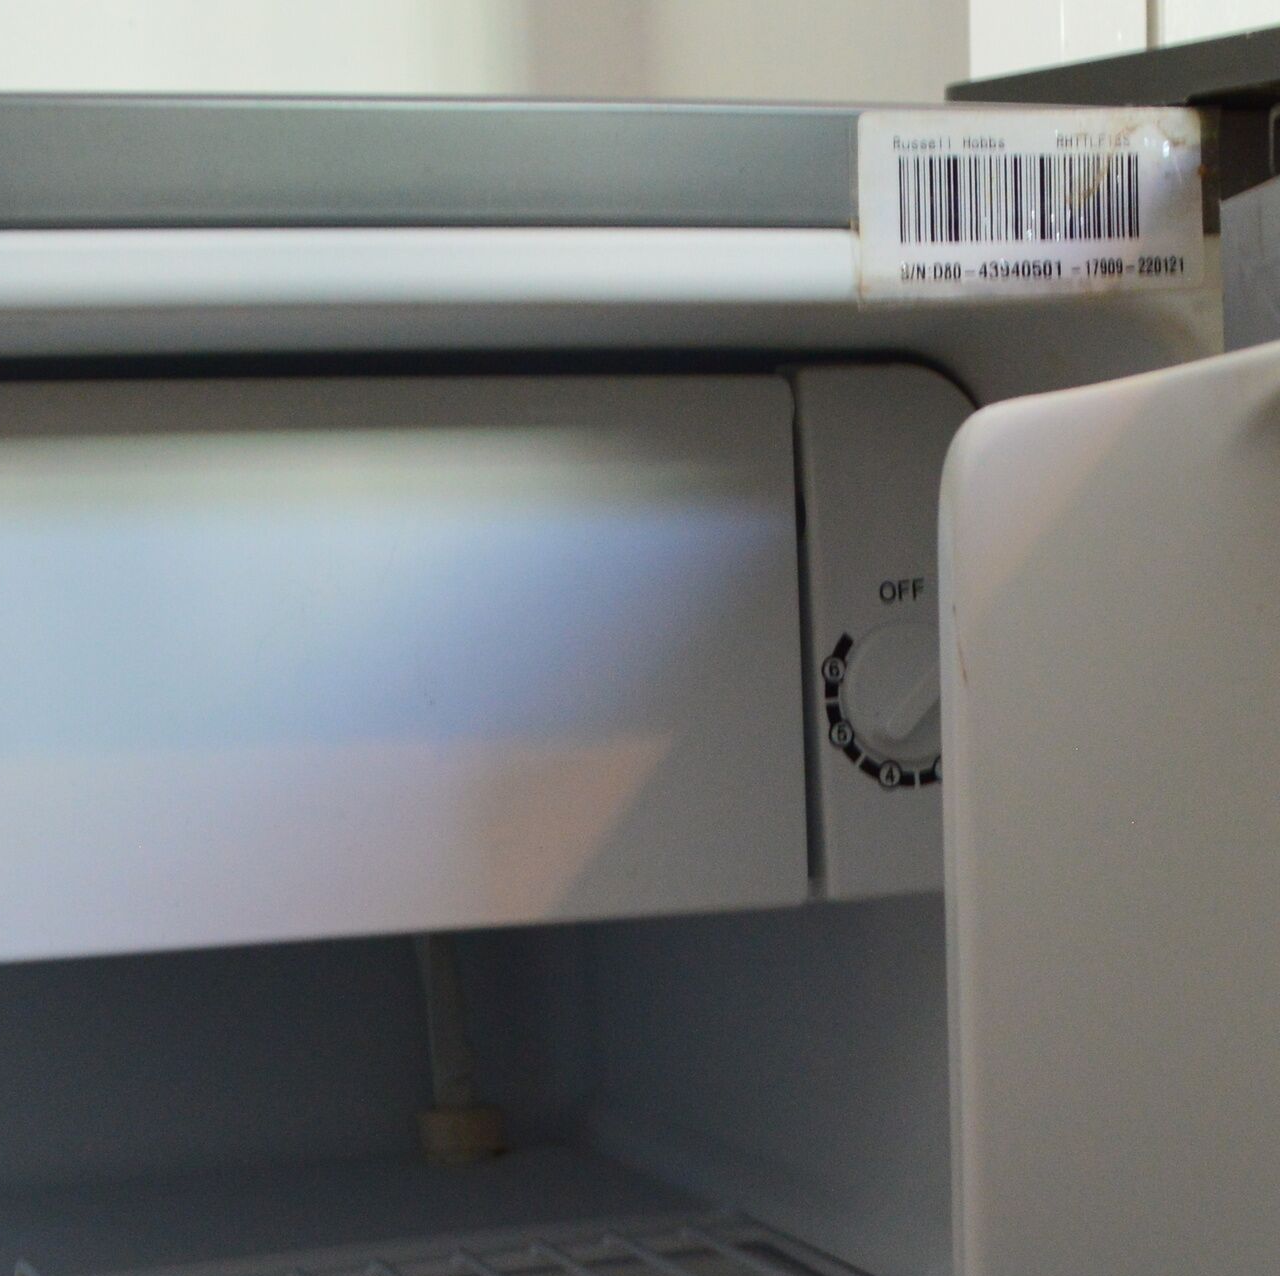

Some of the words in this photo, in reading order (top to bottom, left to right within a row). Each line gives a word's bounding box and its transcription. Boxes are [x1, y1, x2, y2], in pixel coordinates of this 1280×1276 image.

[892, 135, 952, 150] Russell
[962, 134, 1006, 149] Hobbs
[879, 579, 925, 601] OFF
